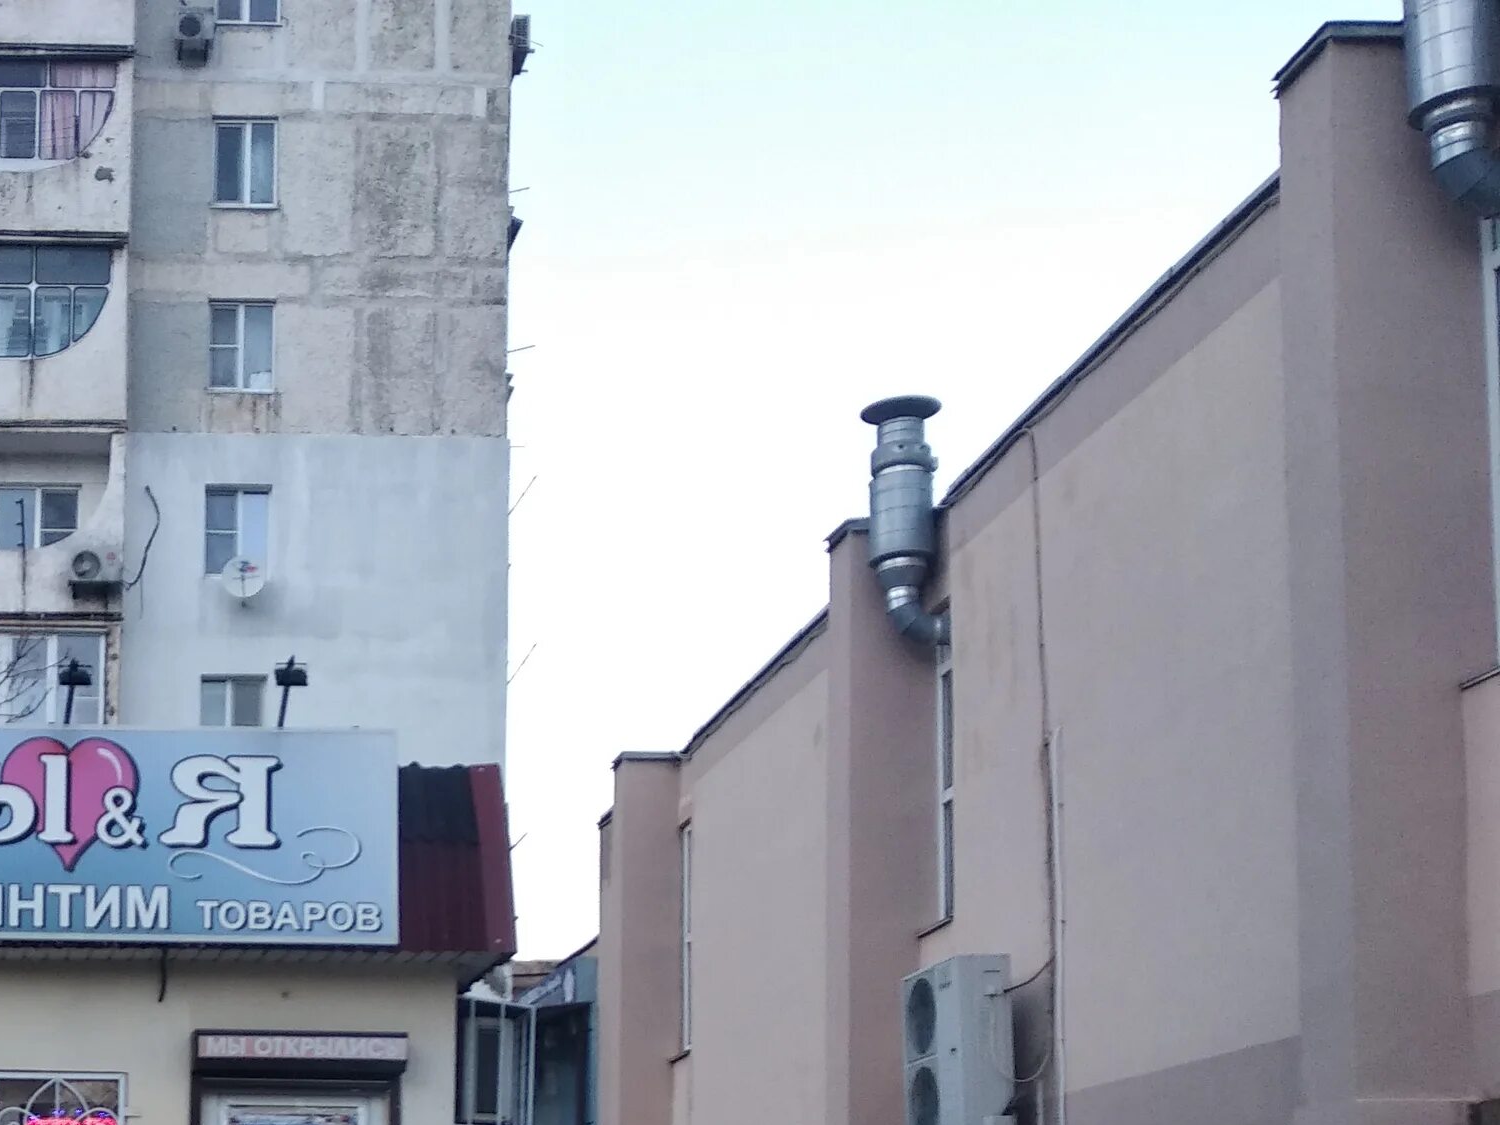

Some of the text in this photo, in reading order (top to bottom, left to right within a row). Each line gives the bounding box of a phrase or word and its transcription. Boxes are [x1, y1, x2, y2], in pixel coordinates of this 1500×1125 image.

[159, 753, 283, 849] Я
[197, 899, 384, 932] ТОВАРОВ
[206, 1036, 246, 1056] МЫ
